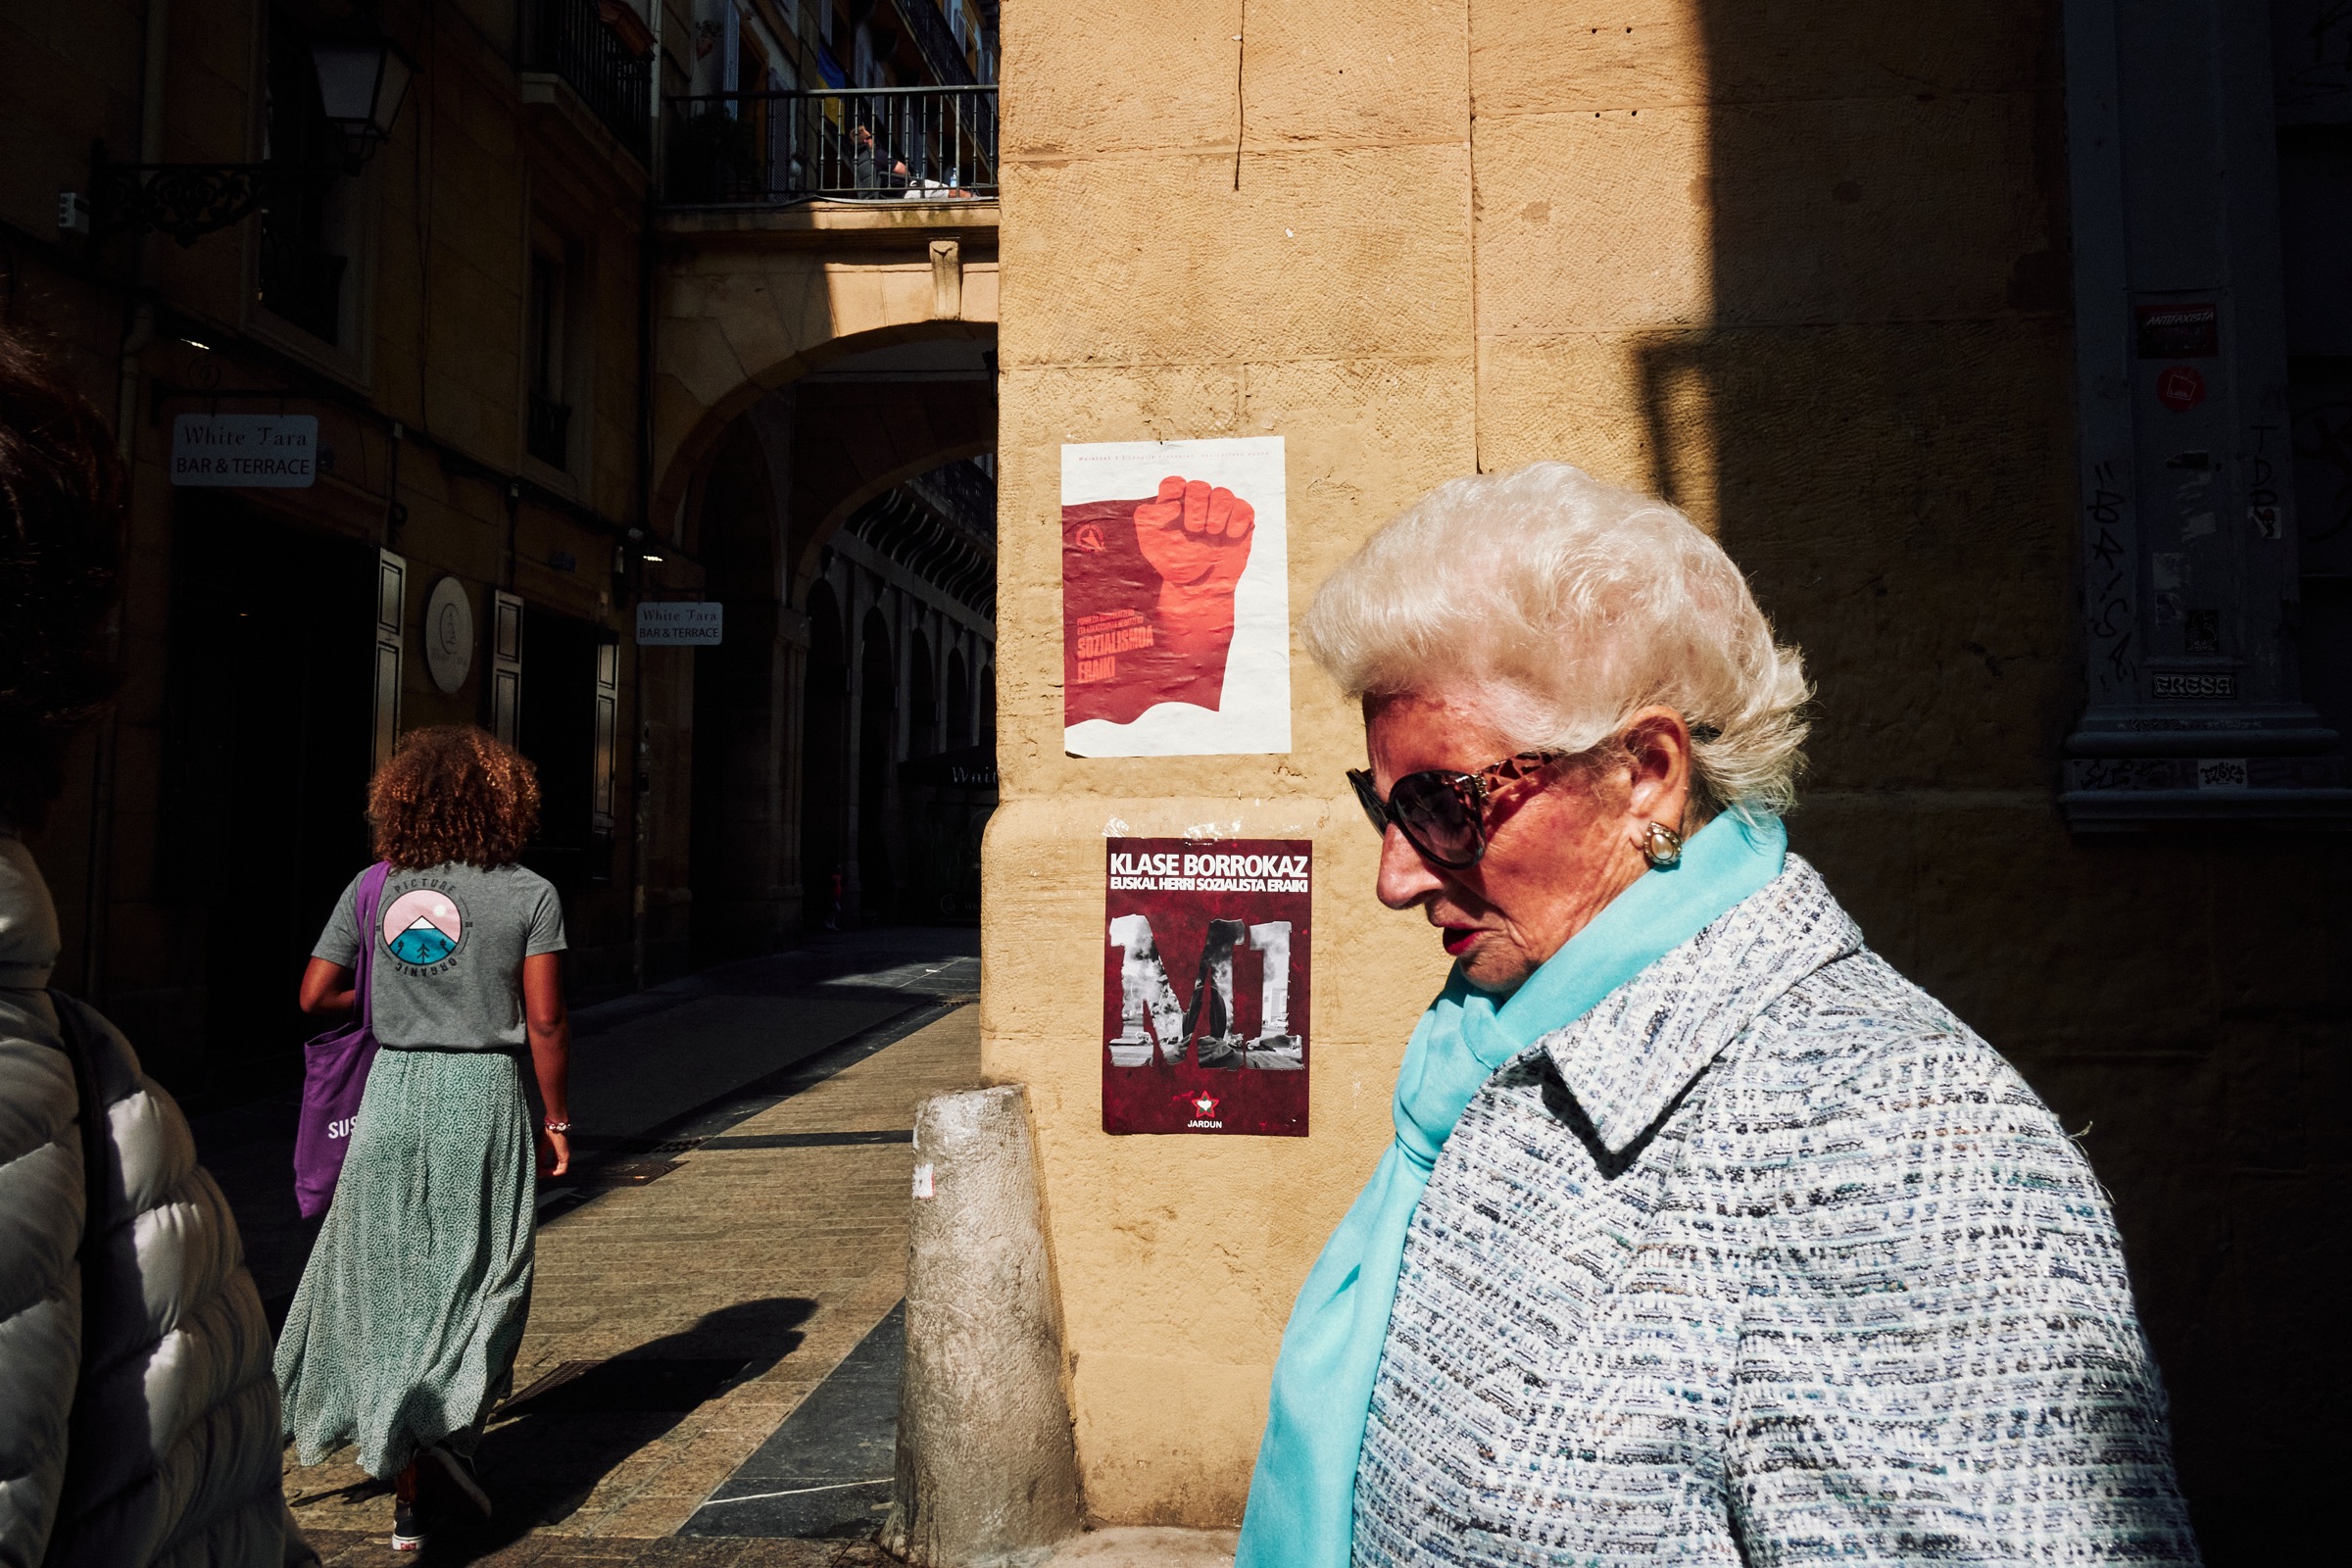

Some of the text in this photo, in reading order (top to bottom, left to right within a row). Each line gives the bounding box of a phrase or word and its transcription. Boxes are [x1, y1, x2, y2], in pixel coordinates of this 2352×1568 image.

[185, 426, 307, 446] White Tara
[176, 458, 311, 475] BAR & TERRACE
[643, 610, 716, 621] White Tara
[639, 627, 719, 638] BAR & TERRACE
[1077, 625, 1154, 659] SOZIALISMOA
[2155, 675, 2232, 696] FRESA
[1110, 854, 1308, 878] KLASE BORROKAZ
[394, 878, 456, 894] PICTURE
[1109, 877, 1308, 893] EUSKAL HERRI SOZIALISTA ERAIKI
[396, 956, 457, 976] ORGANIC
[1187, 1120, 1223, 1129] JARDUN
